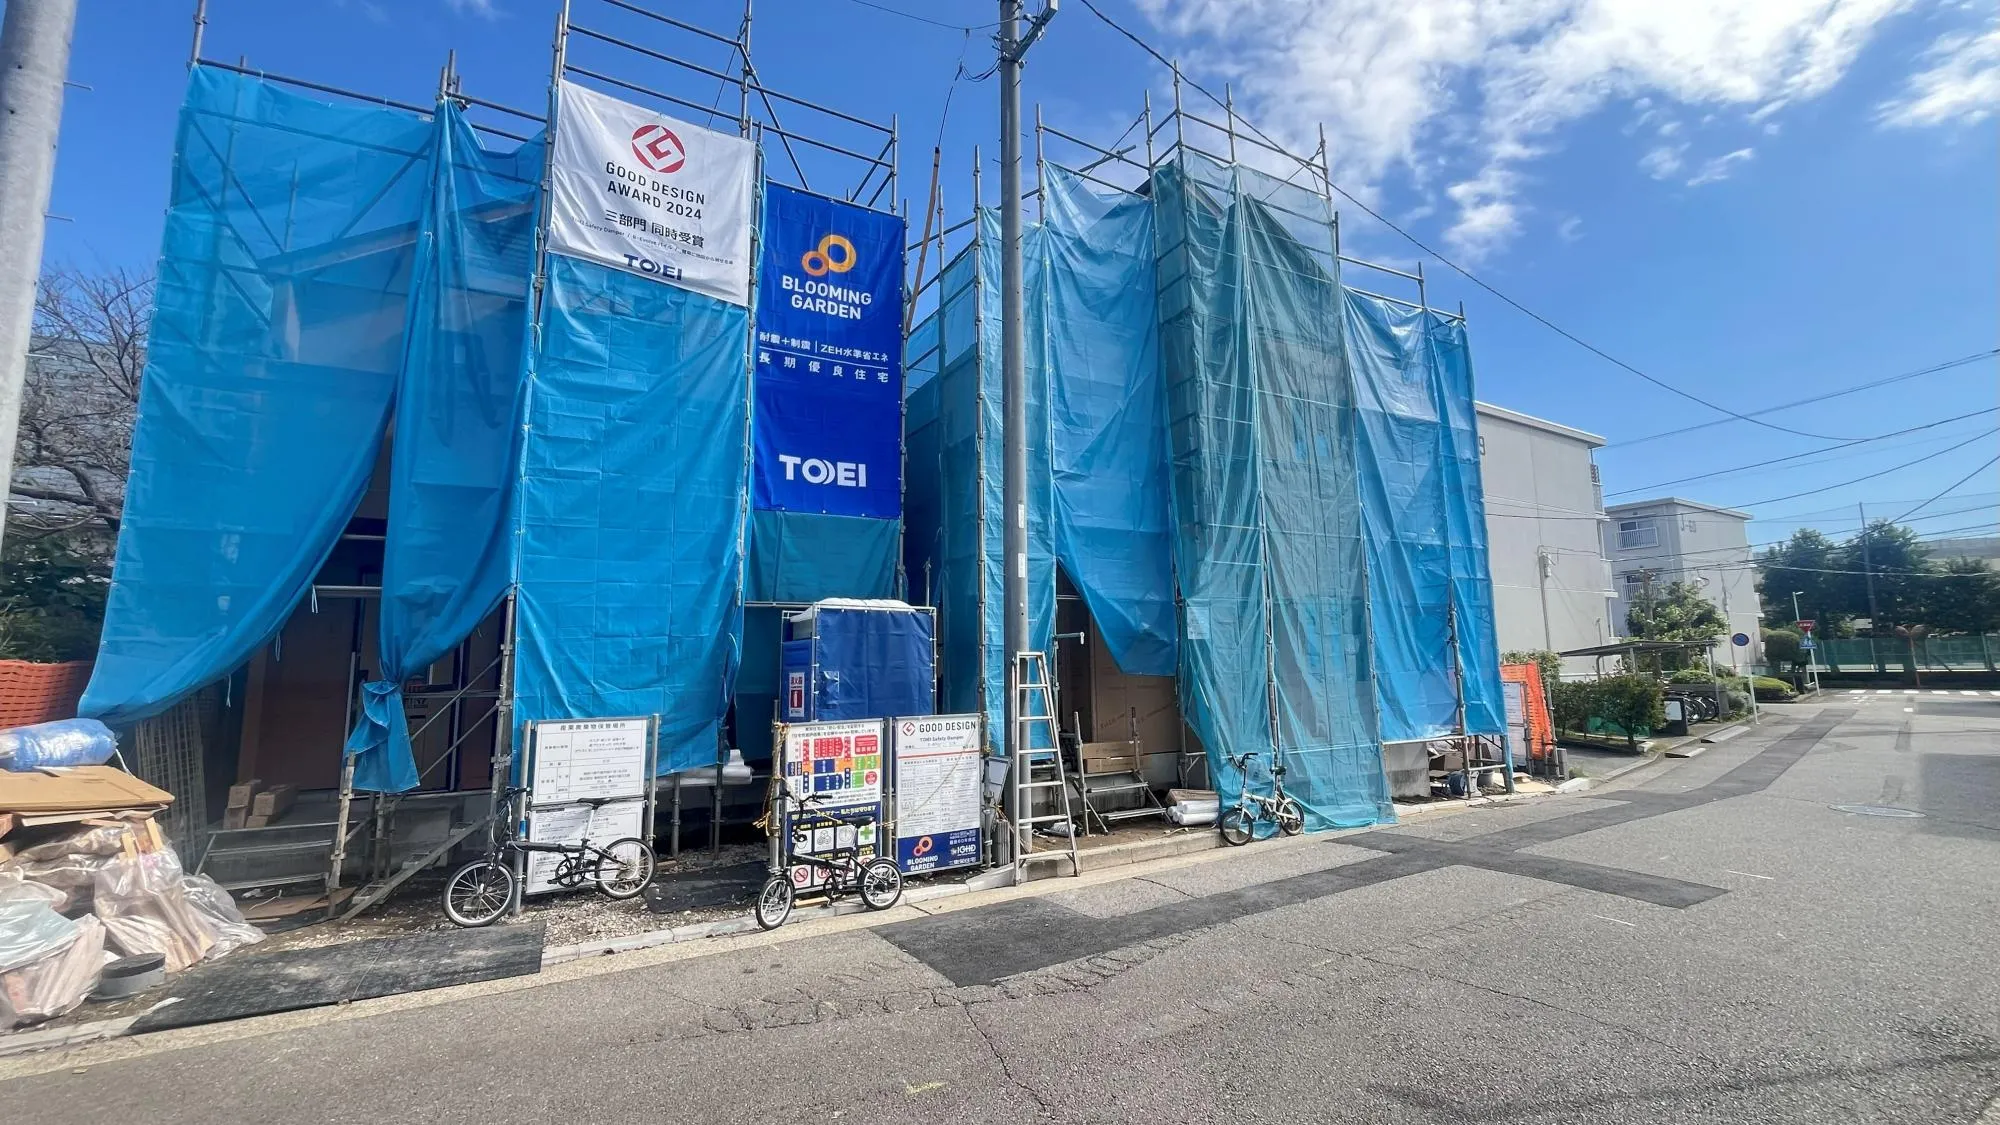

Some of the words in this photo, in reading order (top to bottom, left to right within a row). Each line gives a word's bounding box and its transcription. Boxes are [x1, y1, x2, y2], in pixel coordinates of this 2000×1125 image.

[606, 162, 647, 187] GOOD
[652, 181, 706, 205] DESIGN
[607, 180, 661, 208] AWARD
[666, 201, 702, 220] 2024
[605, 209, 647, 233] 三部門
[651, 222, 705, 248] 同時受賞
[623, 253, 683, 281] TOEI
[782, 276, 872, 306] BLOOMING
[791, 294, 862, 320] GARDEN
[779, 454, 867, 488] TOEI
[919, 722, 943, 733] GOOD
[945, 721, 976, 731] DESIGN
[907, 855, 938, 866] BLOOMING
[910, 862, 935, 871] GARDEN
